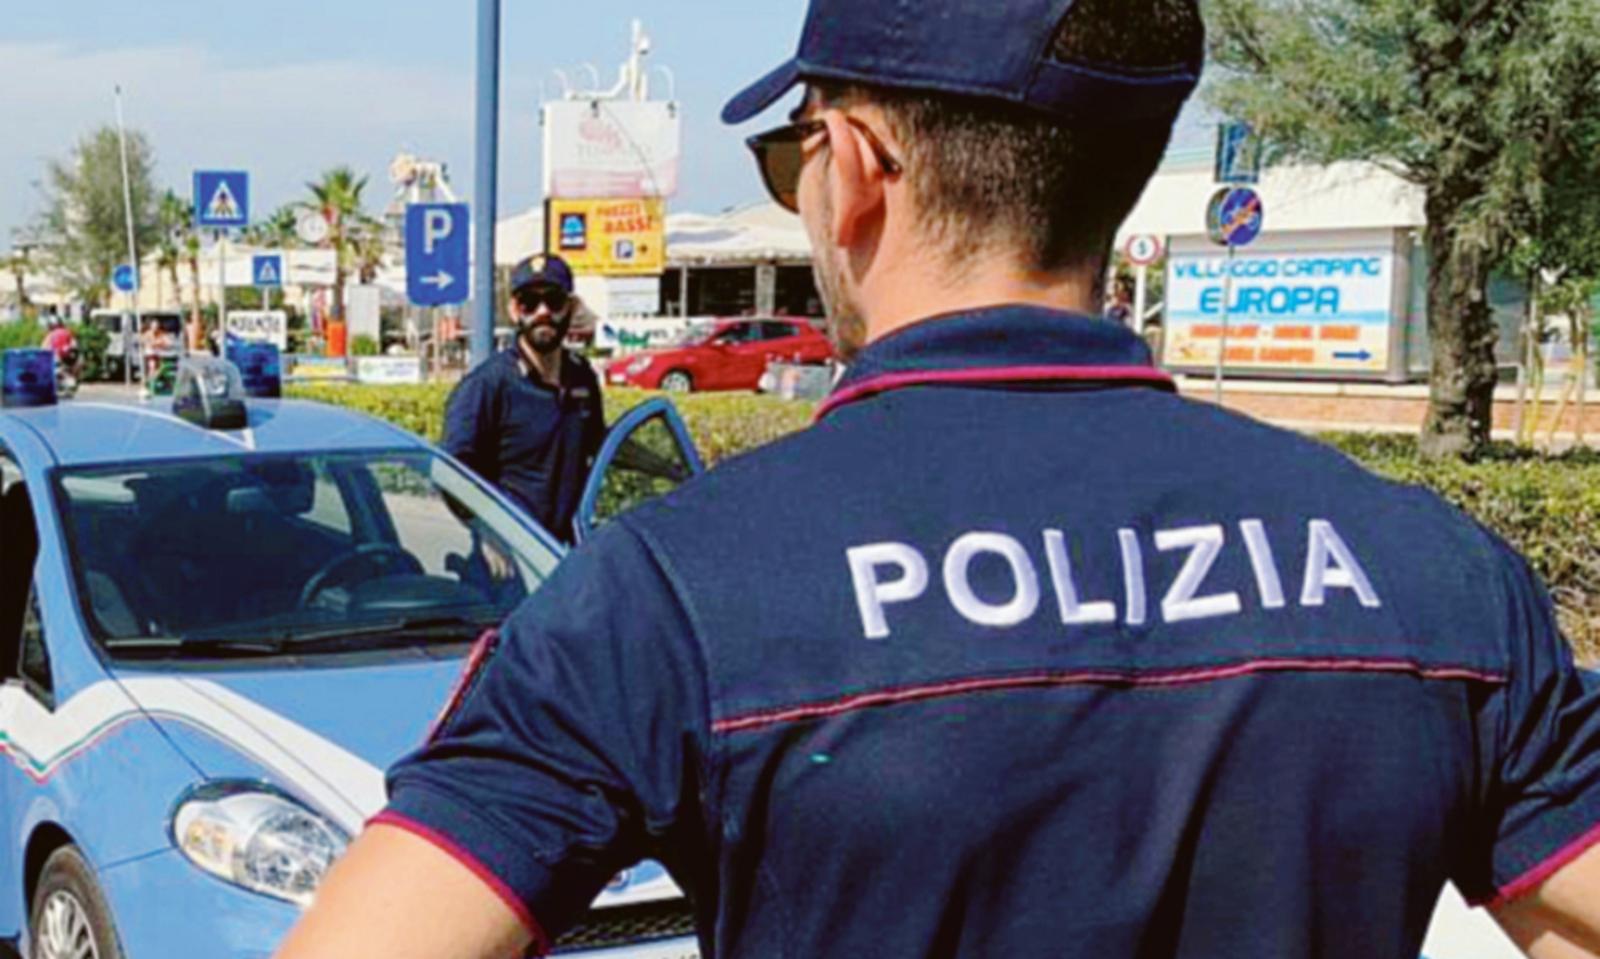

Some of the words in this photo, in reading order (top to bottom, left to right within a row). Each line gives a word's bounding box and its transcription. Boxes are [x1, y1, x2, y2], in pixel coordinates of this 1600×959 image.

[424, 209, 453, 254] P
[1281, 256, 1381, 277] CAMPING
[1200, 286, 1340, 314] EUROPA
[846, 519, 1381, 638] POLIZIA
